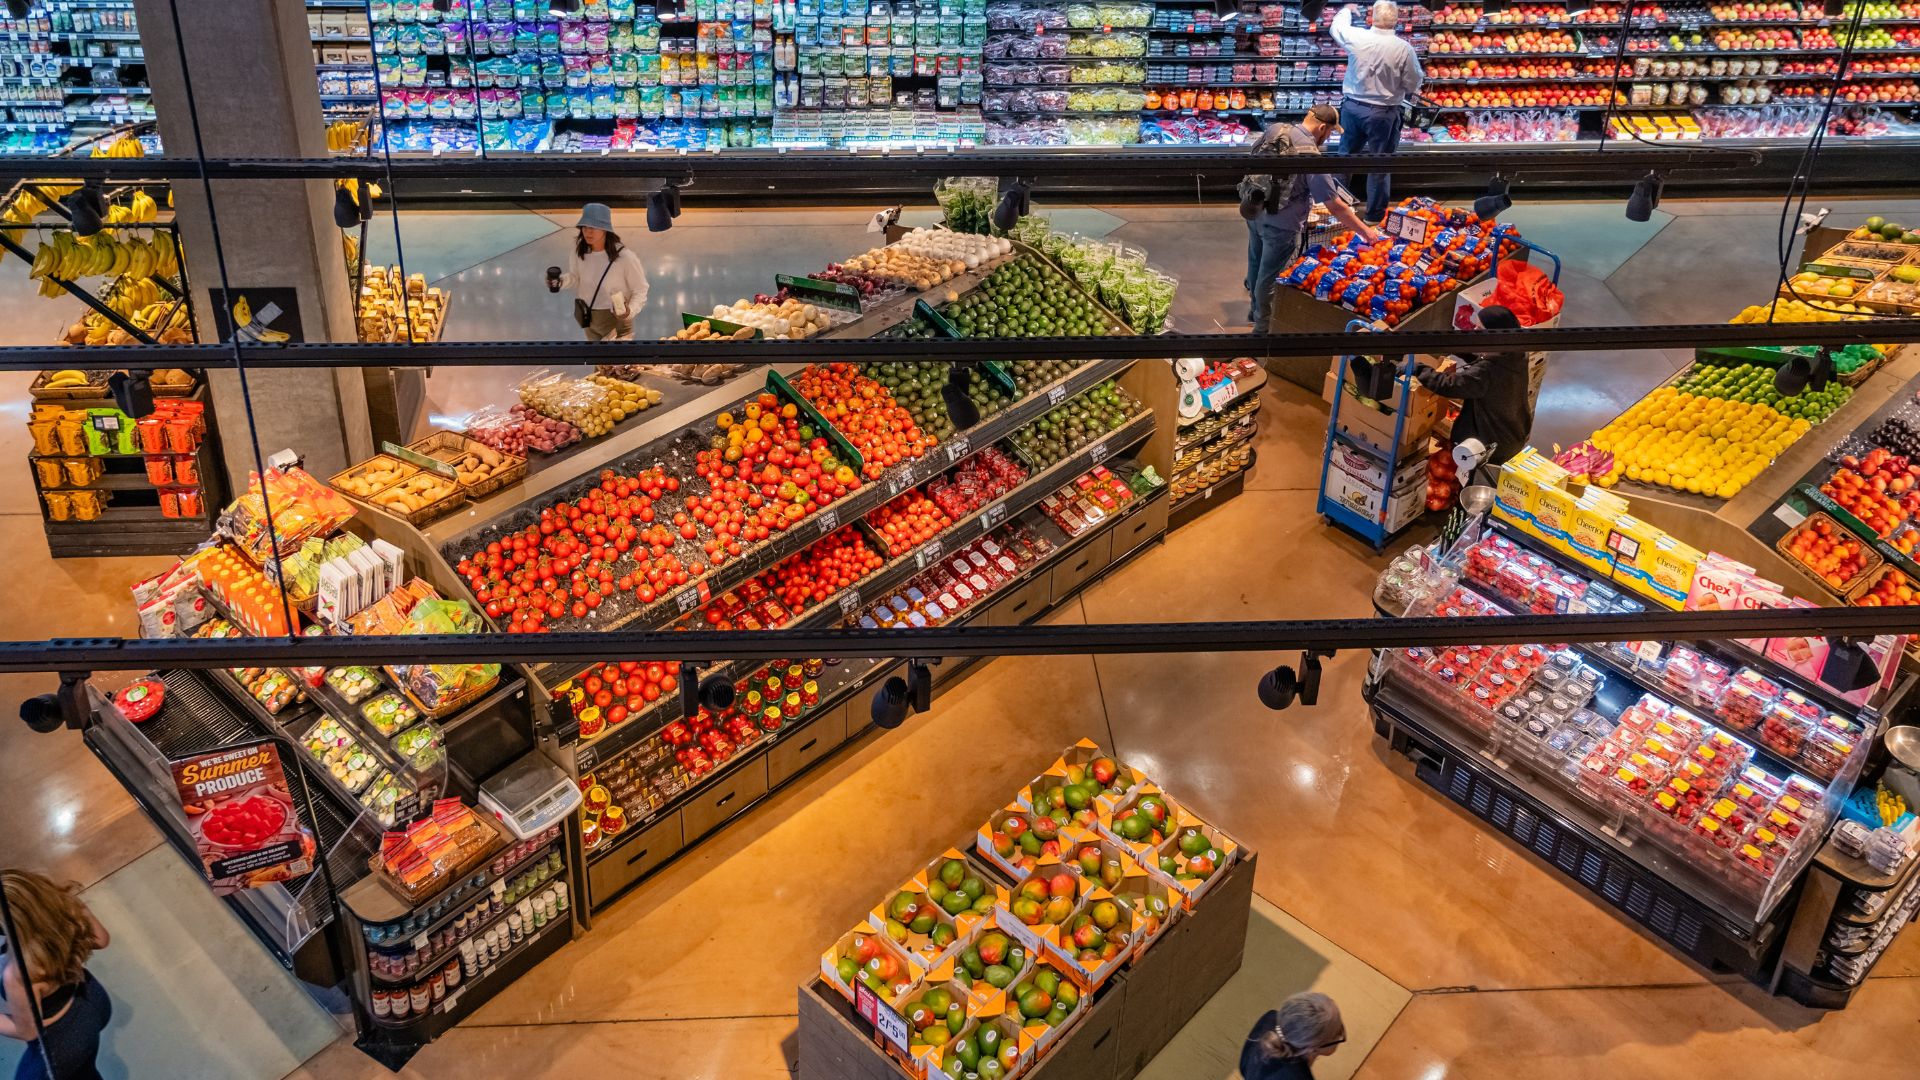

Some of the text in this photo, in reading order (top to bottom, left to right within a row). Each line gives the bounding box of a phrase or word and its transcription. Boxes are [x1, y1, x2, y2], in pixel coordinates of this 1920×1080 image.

[1502, 477, 1530, 497] Cheerios
[1539, 496, 1567, 517] Cheerios
[1804, 489, 1832, 511] ORGANIC
[1576, 515, 1605, 537] Cheerios
[1656, 555, 1687, 577] Cheerios
[1699, 576, 1731, 597] Chex
[1744, 596, 1760, 610] Ch
[182, 751, 272, 785] Summer
[200, 756, 222, 767] WE'RE
[223, 750, 247, 763] SWEET
[195, 767, 266, 797] PRODUCE
